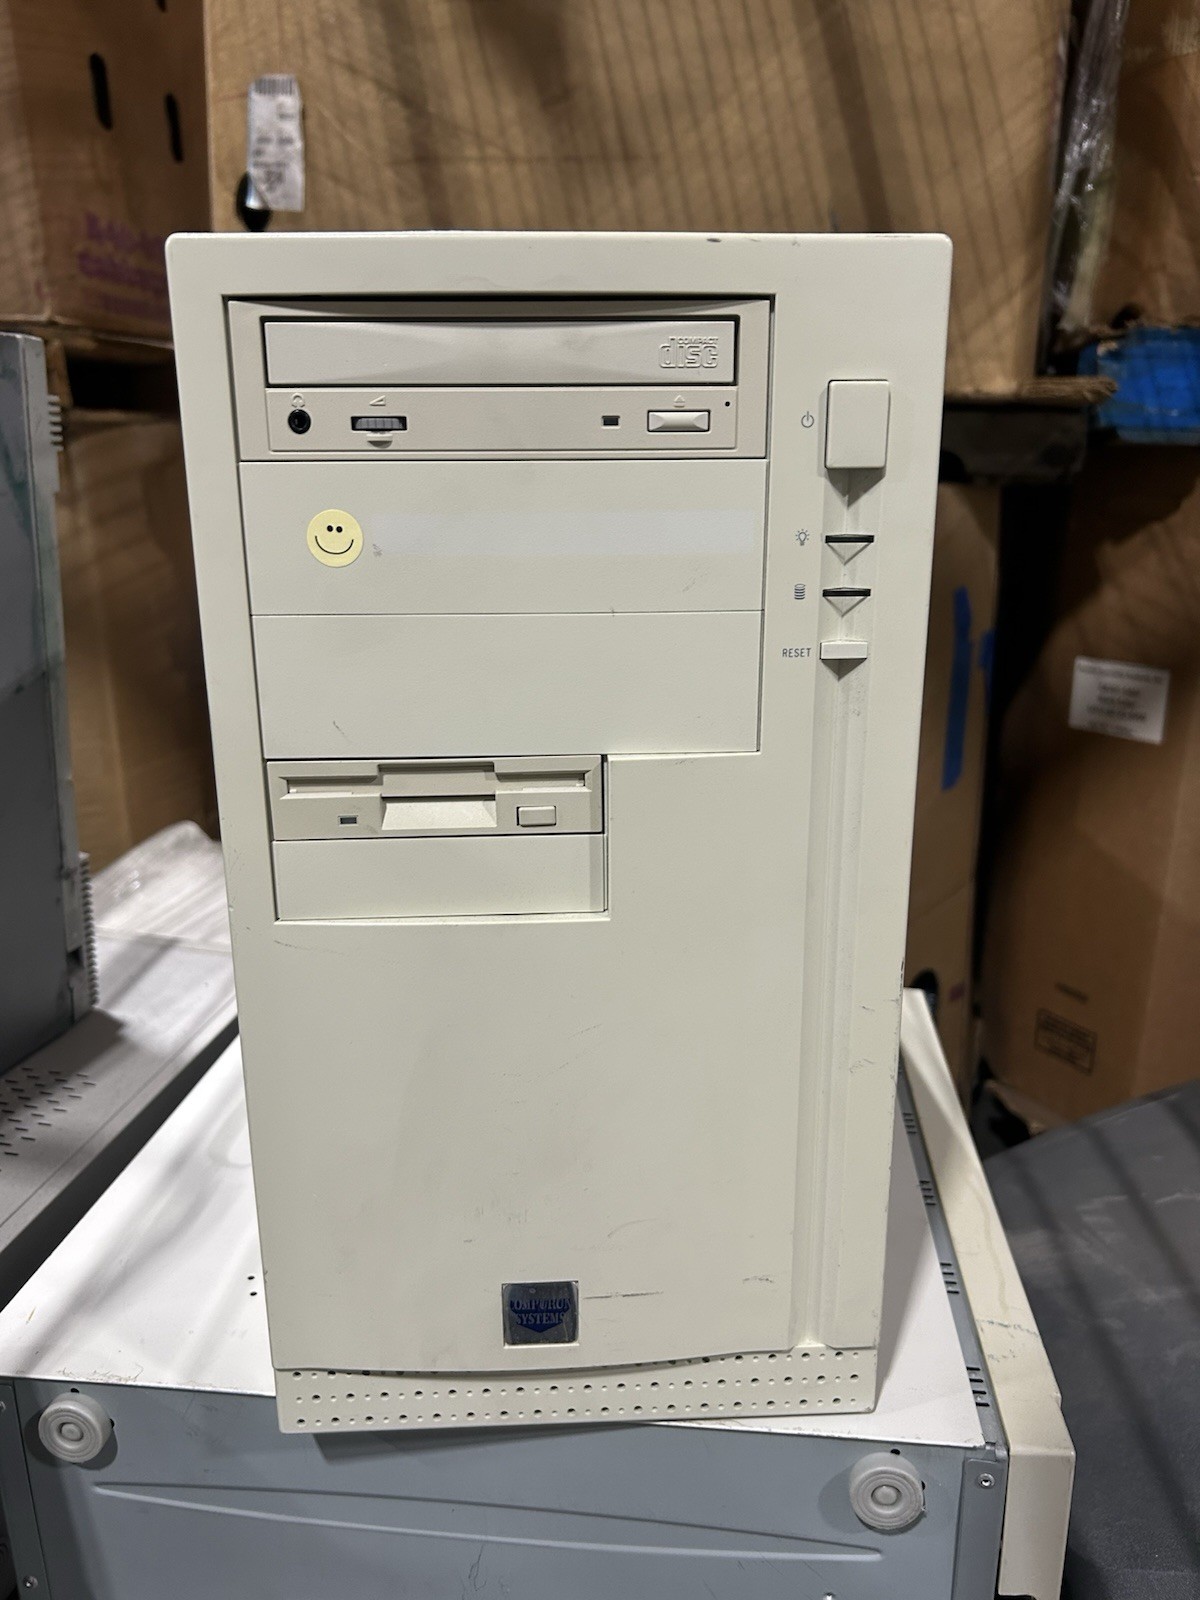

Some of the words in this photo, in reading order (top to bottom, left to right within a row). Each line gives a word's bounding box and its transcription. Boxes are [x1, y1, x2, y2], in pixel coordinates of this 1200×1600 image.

[677, 336, 719, 345] COMPACT
[782, 647, 811, 658] RESET
[516, 1312, 565, 1325] SYSTEMS
